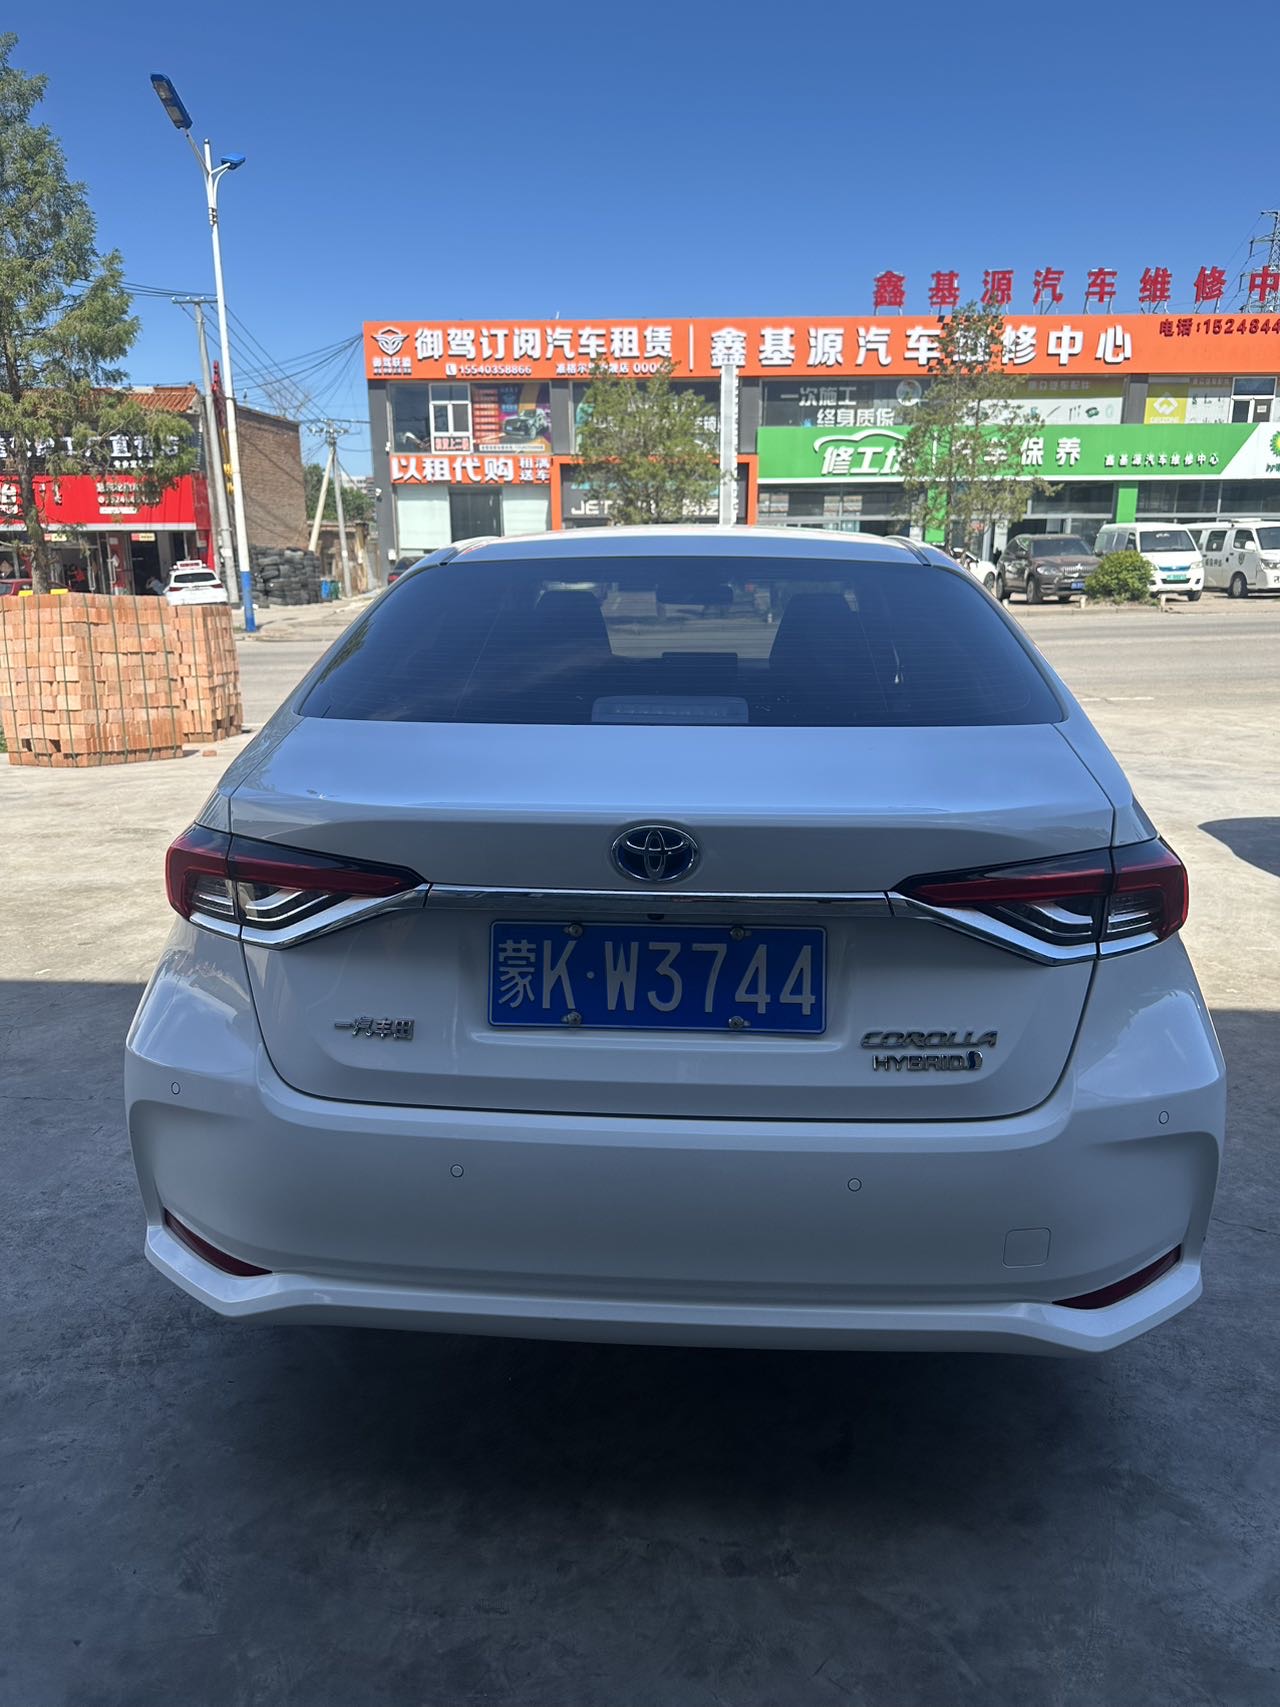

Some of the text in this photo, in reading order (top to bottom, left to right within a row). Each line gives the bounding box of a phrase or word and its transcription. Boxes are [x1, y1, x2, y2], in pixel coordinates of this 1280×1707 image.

[873, 265, 1280, 307] 鑫基源汽车维修中
[415, 326, 673, 361] 御驾订阅汽车租赁
[780, 386, 857, 407] 一次施工
[816, 407, 895, 427] 终身质保
[391, 456, 515, 483] 以租代购
[334, 1016, 415, 1041] 一汽丰田
[860, 1030, 999, 1049] COROLLA
[872, 1053, 968, 1072] HYBRID
